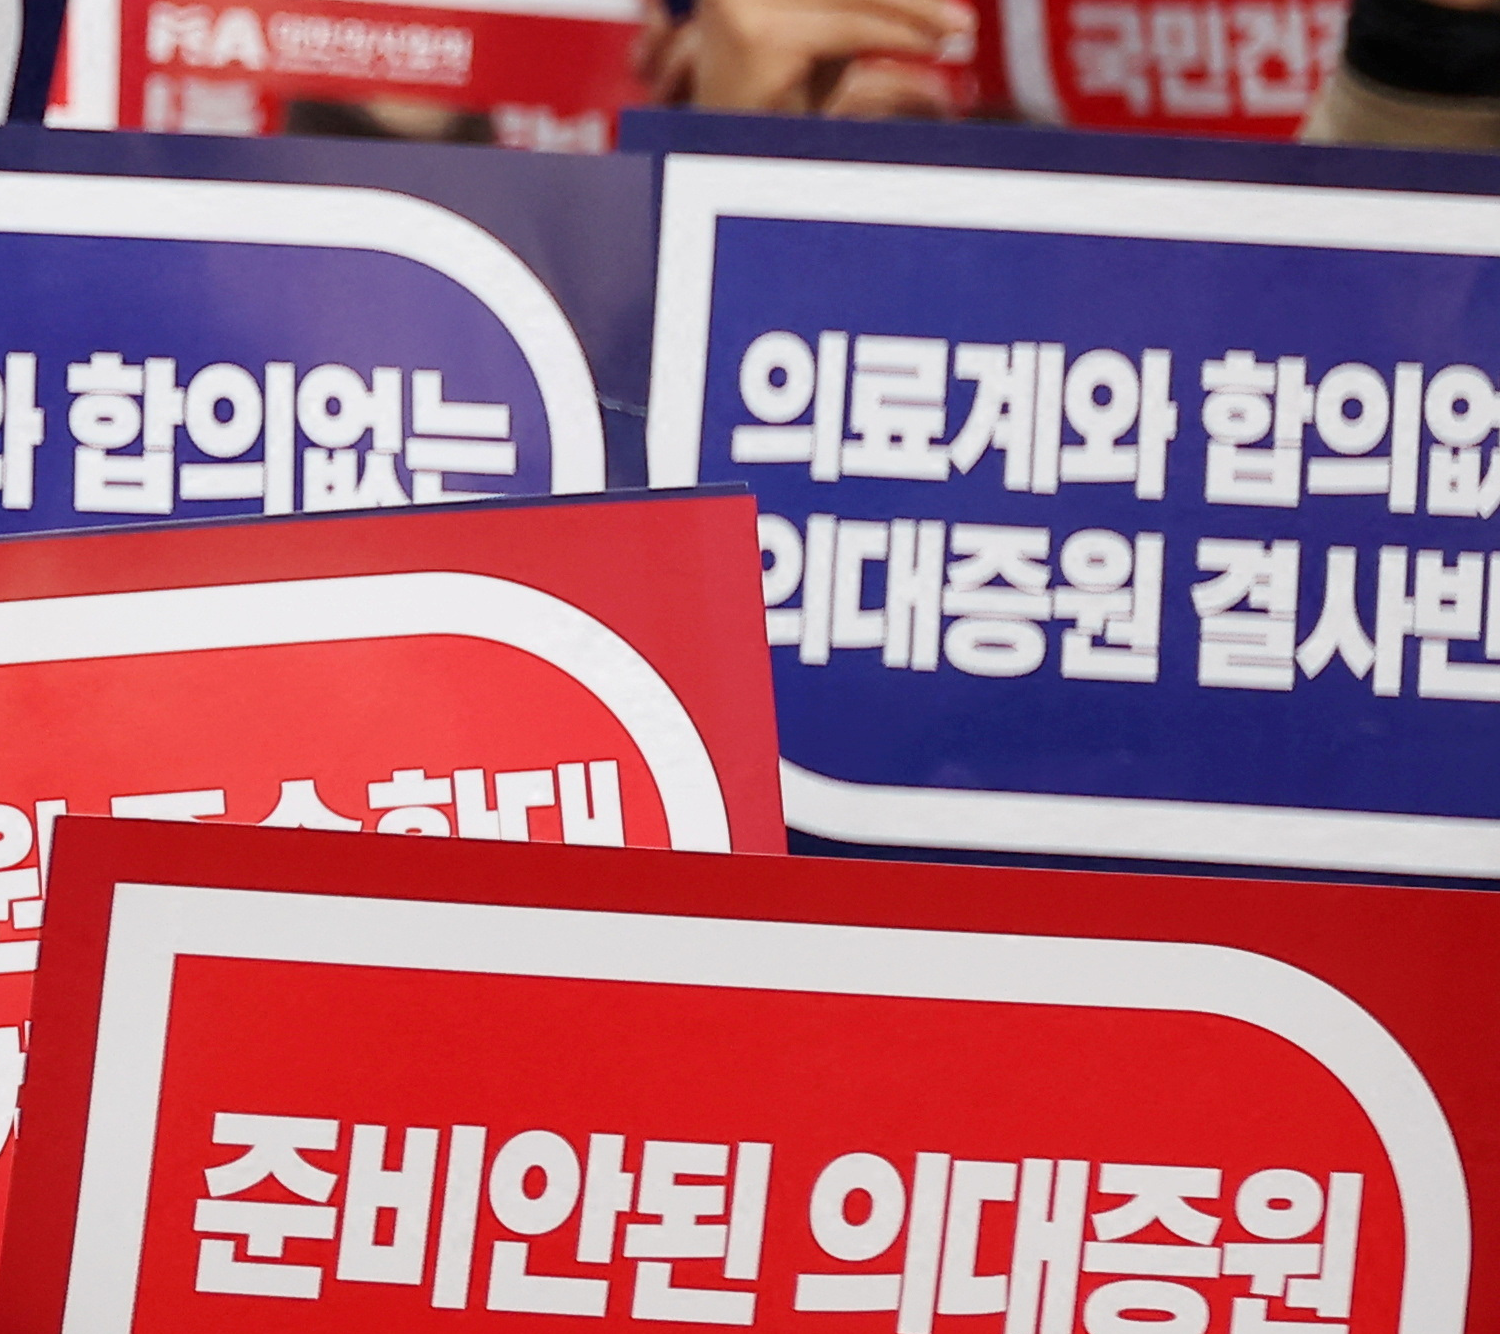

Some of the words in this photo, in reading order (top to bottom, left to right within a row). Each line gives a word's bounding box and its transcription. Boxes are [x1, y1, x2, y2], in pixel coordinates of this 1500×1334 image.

[63, 352, 518, 519] 합의없는
[730, 329, 1178, 500] 의료계와
[755, 512, 1166, 684] 의대증원
[191, 1111, 772, 1325] 준비안된
